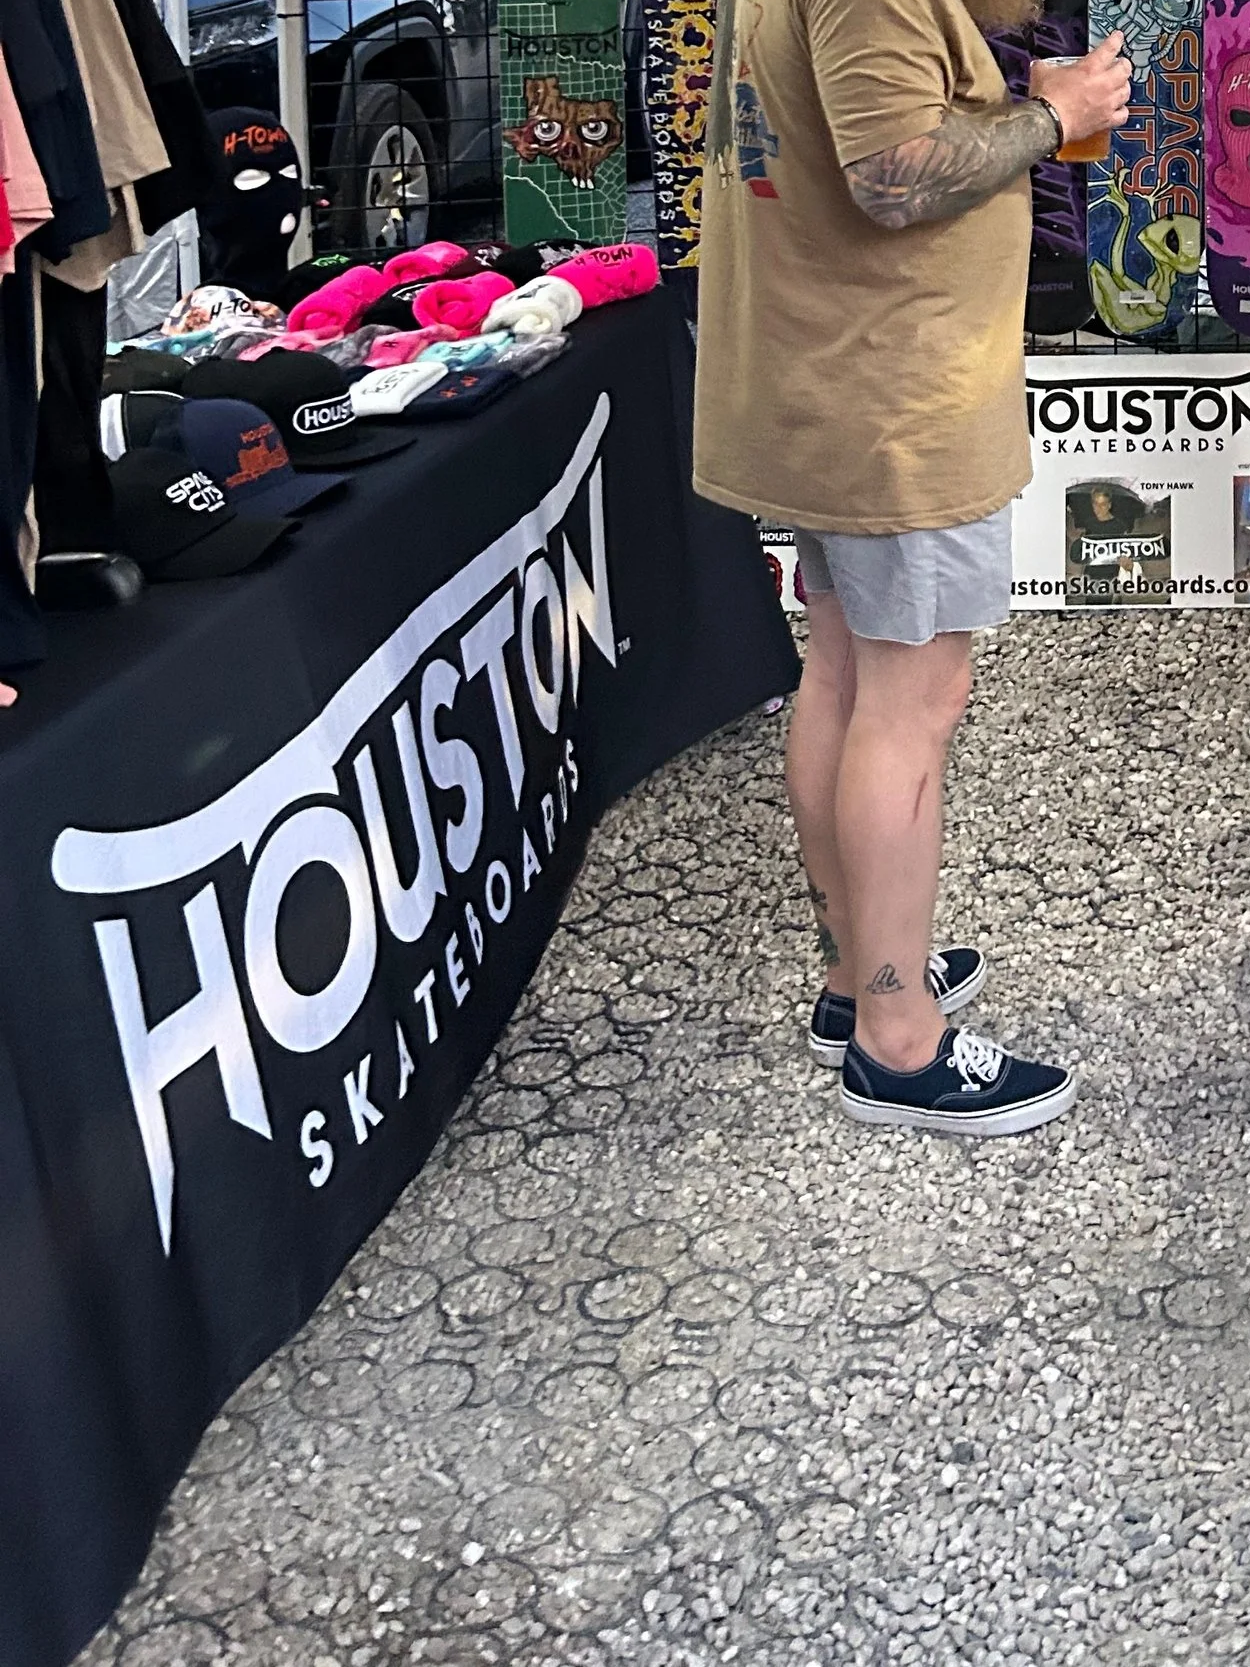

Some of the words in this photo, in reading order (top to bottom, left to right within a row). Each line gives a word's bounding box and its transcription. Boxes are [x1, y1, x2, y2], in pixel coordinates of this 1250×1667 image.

[504, 24, 620, 58] HOUSTON
[1042, 437, 1226, 455] SKATEBOARDS
[1140, 482, 1165, 490] TONY
[1167, 482, 1194, 490] HAWK
[51, 391, 618, 1260] HOUSTON
[299, 736, 581, 1189] SKATEBOARDS
